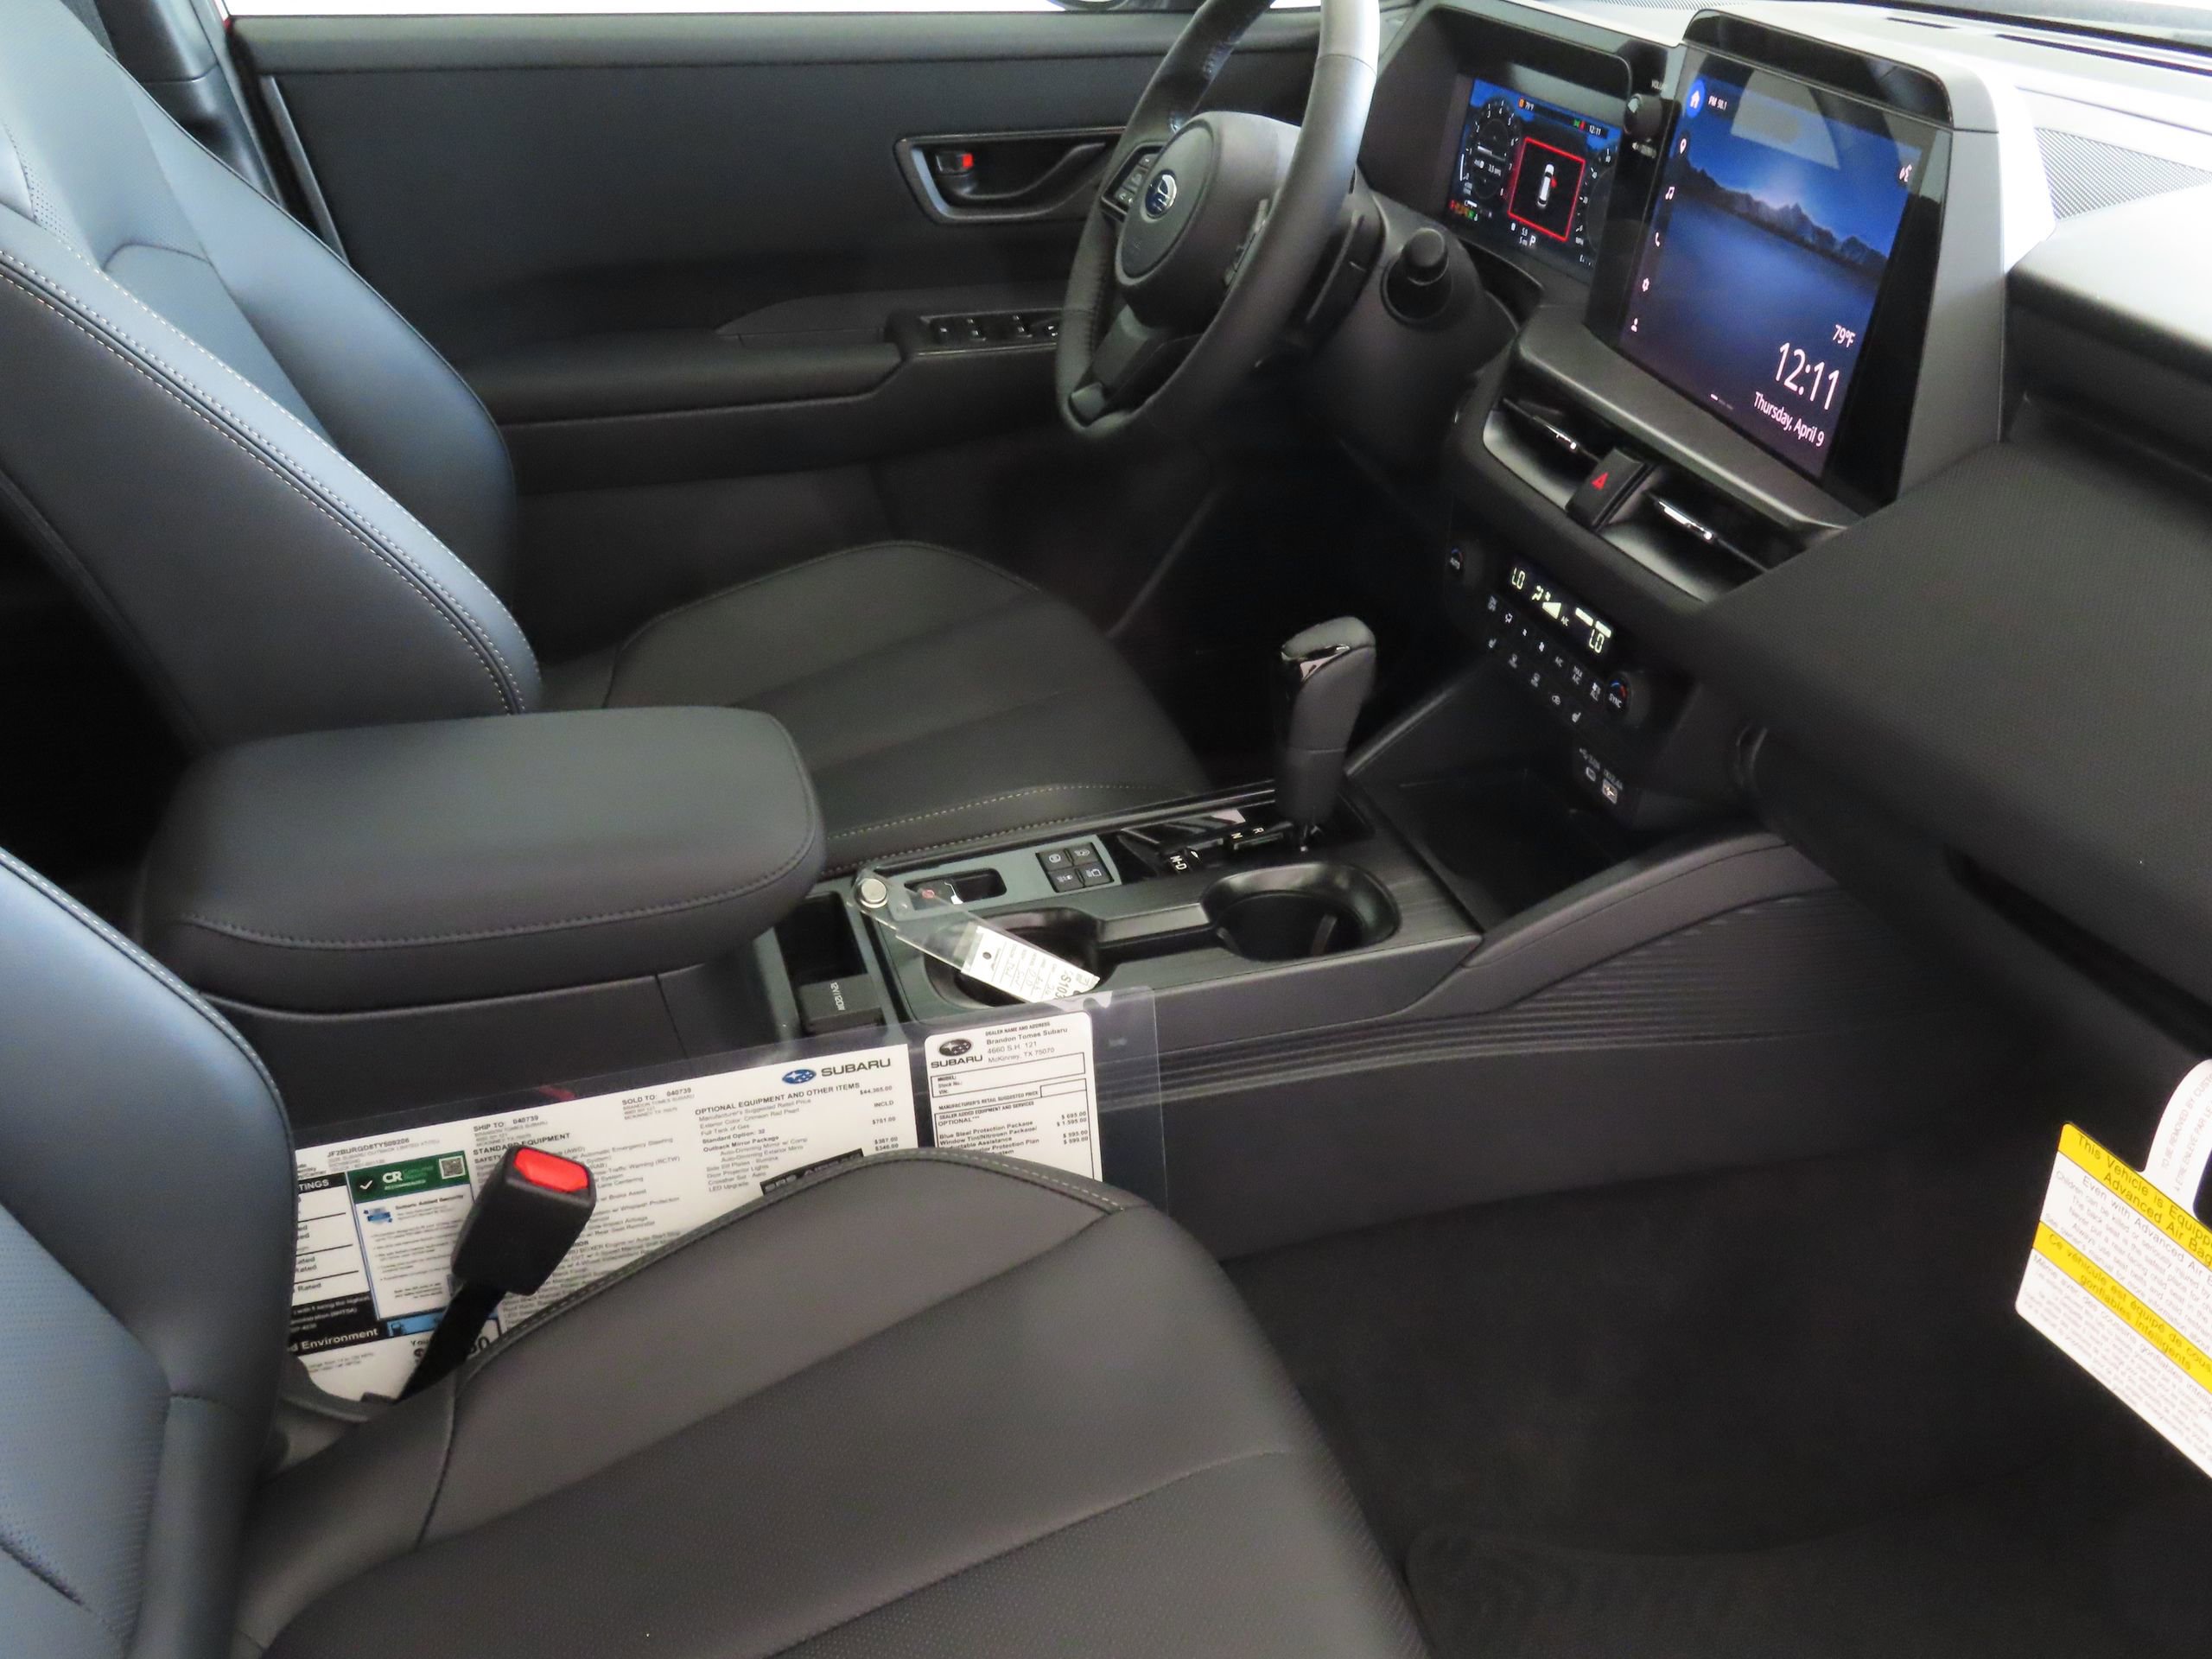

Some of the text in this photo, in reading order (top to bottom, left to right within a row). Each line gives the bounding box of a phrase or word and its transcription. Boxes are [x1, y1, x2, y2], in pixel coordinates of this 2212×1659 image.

[1589, 124, 1602, 136] 12:11
[1529, 235, 1536, 246] P
[1833, 324, 1856, 347] 79°F
[1775, 342, 1840, 410] 12:11
[1753, 391, 1825, 447] Thursday, April 9
[1512, 567, 1526, 590] LO
[1588, 628, 1605, 654] LO
[1609, 693, 1623, 709] SYNC
[1170, 855, 1187, 870] M-D
[987, 1035, 1016, 1045] Brandon
[821, 1058, 891, 1077] SUBARU
[931, 1055, 982, 1068] SUBARU
[695, 1103, 735, 1115] OPTIONAL
[739, 1095, 785, 1108] EQUIPMENT
[807, 1087, 834, 1096] OTHER
[836, 1083, 860, 1091] ITEMS
[939, 1101, 980, 1110] MANUFACTURER'S
[974, 1125, 1006, 1134] Protection
[1007, 1121, 1033, 1129] Package
[702, 1135, 730, 1144] Standard
[703, 1143, 729, 1152] Outback
[753, 1135, 779, 1144] Package
[992, 1142, 1024, 1151] Protection
[474, 1154, 501, 1164] SAFETY
[382, 1171, 404, 1184] CR
[2077, 1135, 2101, 1160] This
[2106, 1156, 2148, 1197] Vehicle
[2153, 1193, 2164, 1208] is
[299, 1179, 329, 1191] TINGS
[724, 1181, 749, 1191] Upgrade
[2056, 1170, 2083, 1196] Children
[2103, 1172, 2161, 1224] Advanced
[2166, 1220, 2183, 1240] Air
[2082, 1176, 2202, 1277] Even with Advanced Air
[297, 1282, 321, 1291] Rated
[2049, 1233, 2063, 1250] Ce
[2067, 1248, 2107, 1286] véhicule
[2110, 1284, 2126, 1301] est
[2129, 1299, 2165, 1334] équipé
[2169, 1331, 2183, 1348] de
[302, 1327, 378, 1350] Environment
[2134, 1319, 2191, 1371] intelligents
